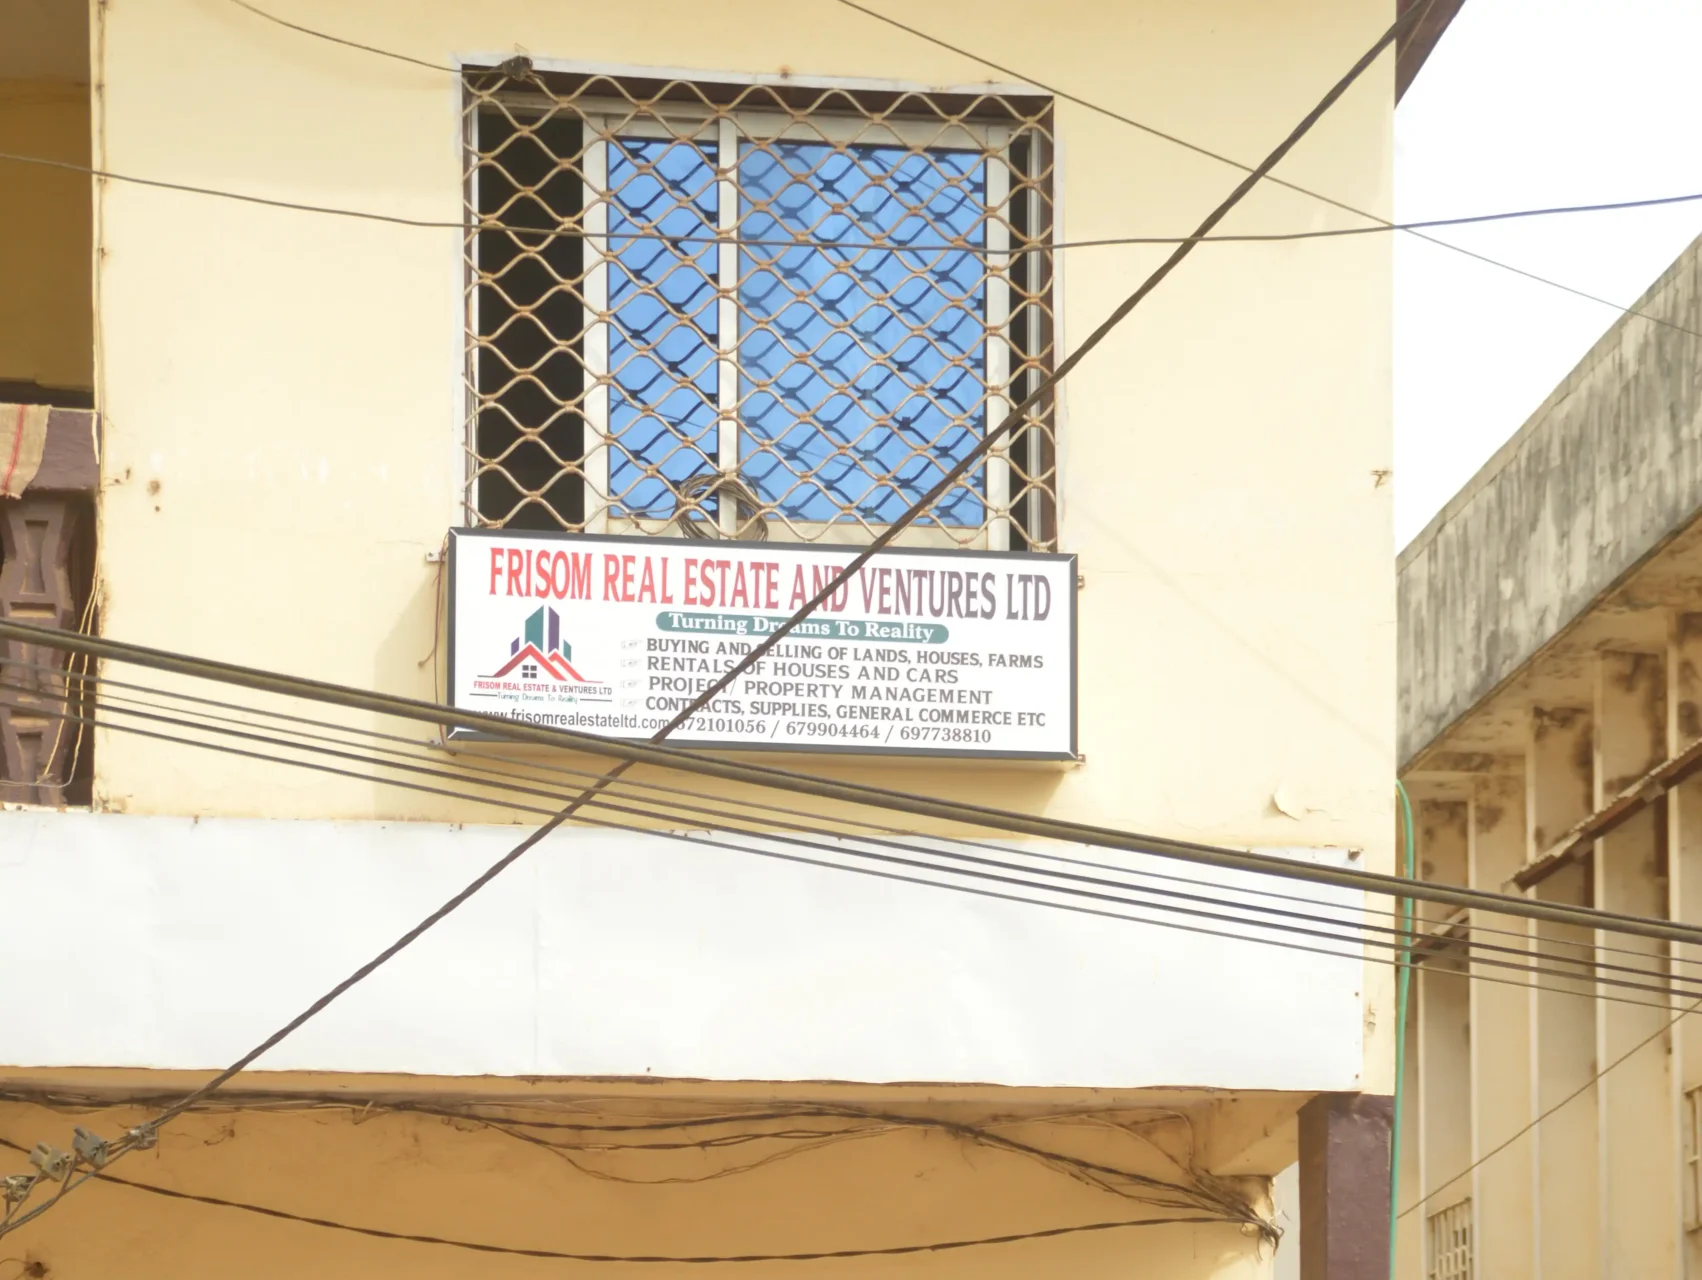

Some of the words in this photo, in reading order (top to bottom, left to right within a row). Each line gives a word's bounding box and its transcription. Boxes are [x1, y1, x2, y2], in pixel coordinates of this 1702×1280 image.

[489, 547, 593, 601] FRISOM
[603, 553, 673, 604] REAL
[683, 557, 779, 610] ESTATE
[788, 563, 849, 613] AND
[857, 566, 997, 620] VENTURES
[1005, 573, 1051, 622] LTD
[668, 612, 748, 635] Turning
[835, 620, 860, 637] To
[864, 622, 934, 643] Reality
[646, 637, 710, 655] BUYING
[715, 640, 752, 657] AND
[827, 647, 848, 661] OF
[853, 648, 911, 665] LANDS,
[916, 650, 983, 668] HOUSES,
[988, 653, 1044, 669] FARMS
[646, 656, 735, 674] RENTALS
[743, 660, 767, 676] OF
[773, 661, 850, 680] HOUSES
[857, 665, 900, 682] AND
[906, 667, 959, 684] CARS
[473, 680, 501, 690] FRISOM
[502, 682, 521, 691] REAL
[523, 683, 550, 692] ESTATE
[552, 684, 557, 692] &
[559, 685, 598, 695] VENTURES
[599, 687, 613, 695] LTD
[547, 693, 556, 702] To
[744, 680, 844, 699] PROPERTY
[851, 685, 993, 705] MANAGEMENT
[474, 708, 671, 730] wfrisomrealestateltd.com
[749, 700, 832, 720] SUPPLIES,
[836, 705, 914, 722] GENERAL
[918, 708, 1012, 726] COMMERCE
[1017, 712, 1046, 727] ETC
[786, 721, 880, 739] 679904464
[900, 726, 992, 743] 697738810
